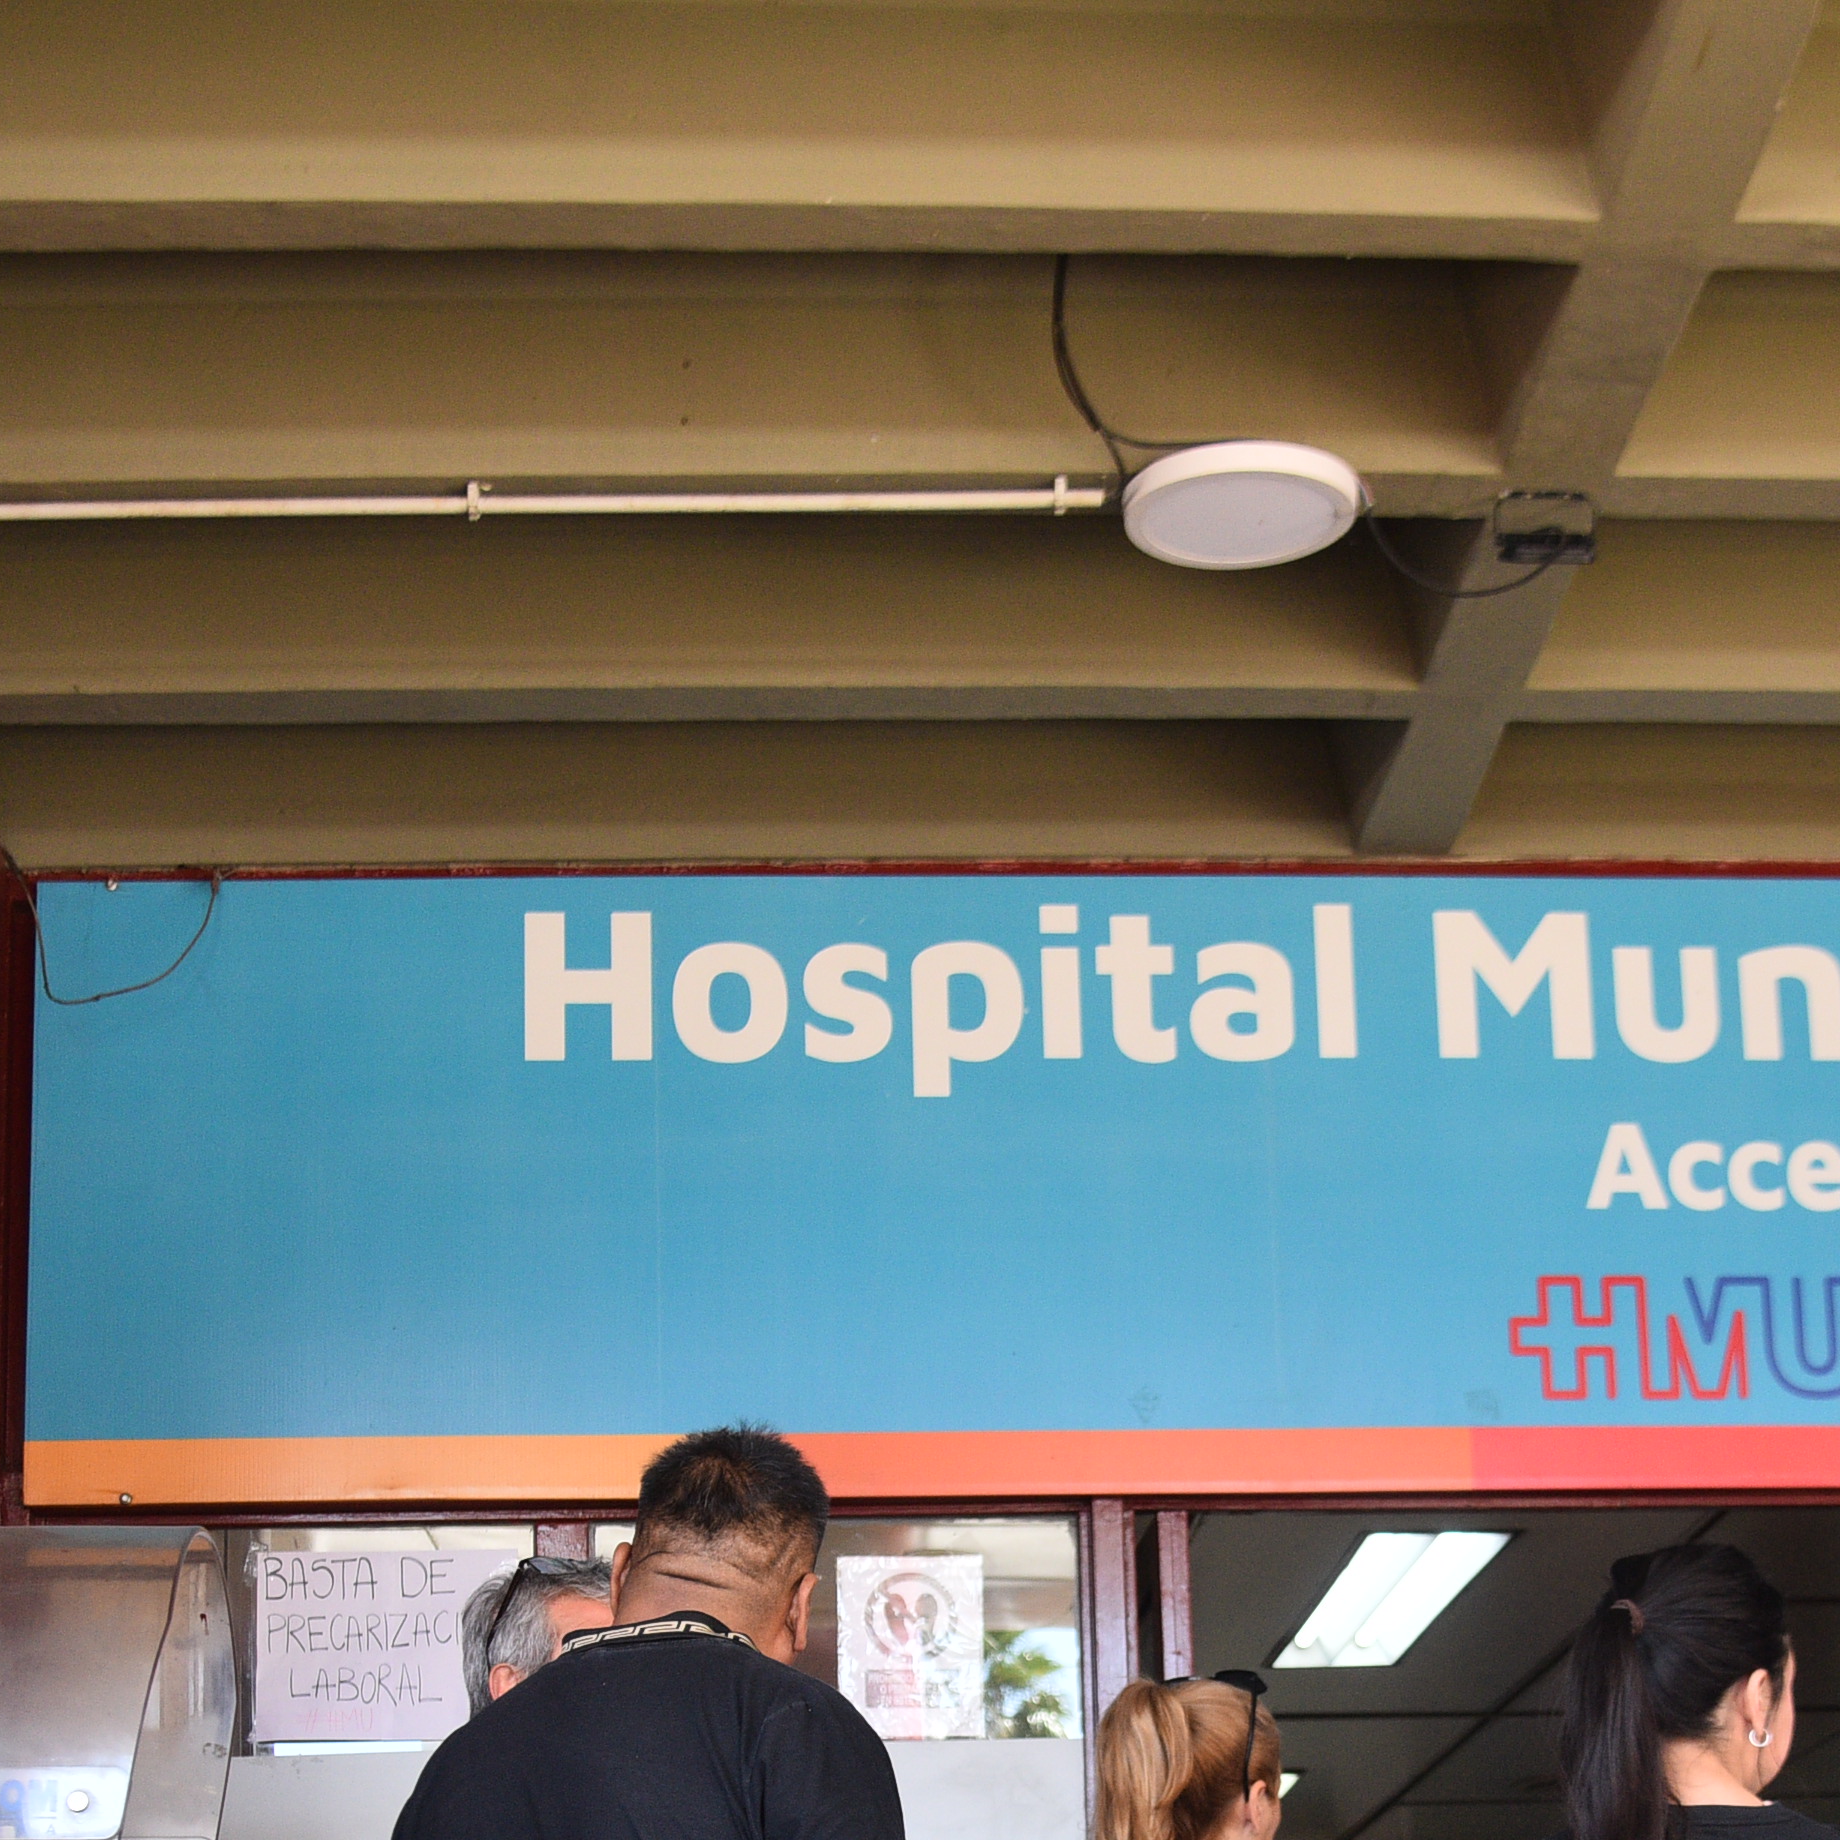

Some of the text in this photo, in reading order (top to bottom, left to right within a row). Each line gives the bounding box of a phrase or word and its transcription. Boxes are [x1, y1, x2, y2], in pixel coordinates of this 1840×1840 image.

[523, 902, 1359, 1099] Hospital
[263, 1556, 456, 1601] BASTA DE
[266, 1609, 461, 1654] PRECARIZACI
[289, 1662, 443, 1707] LABORAL
